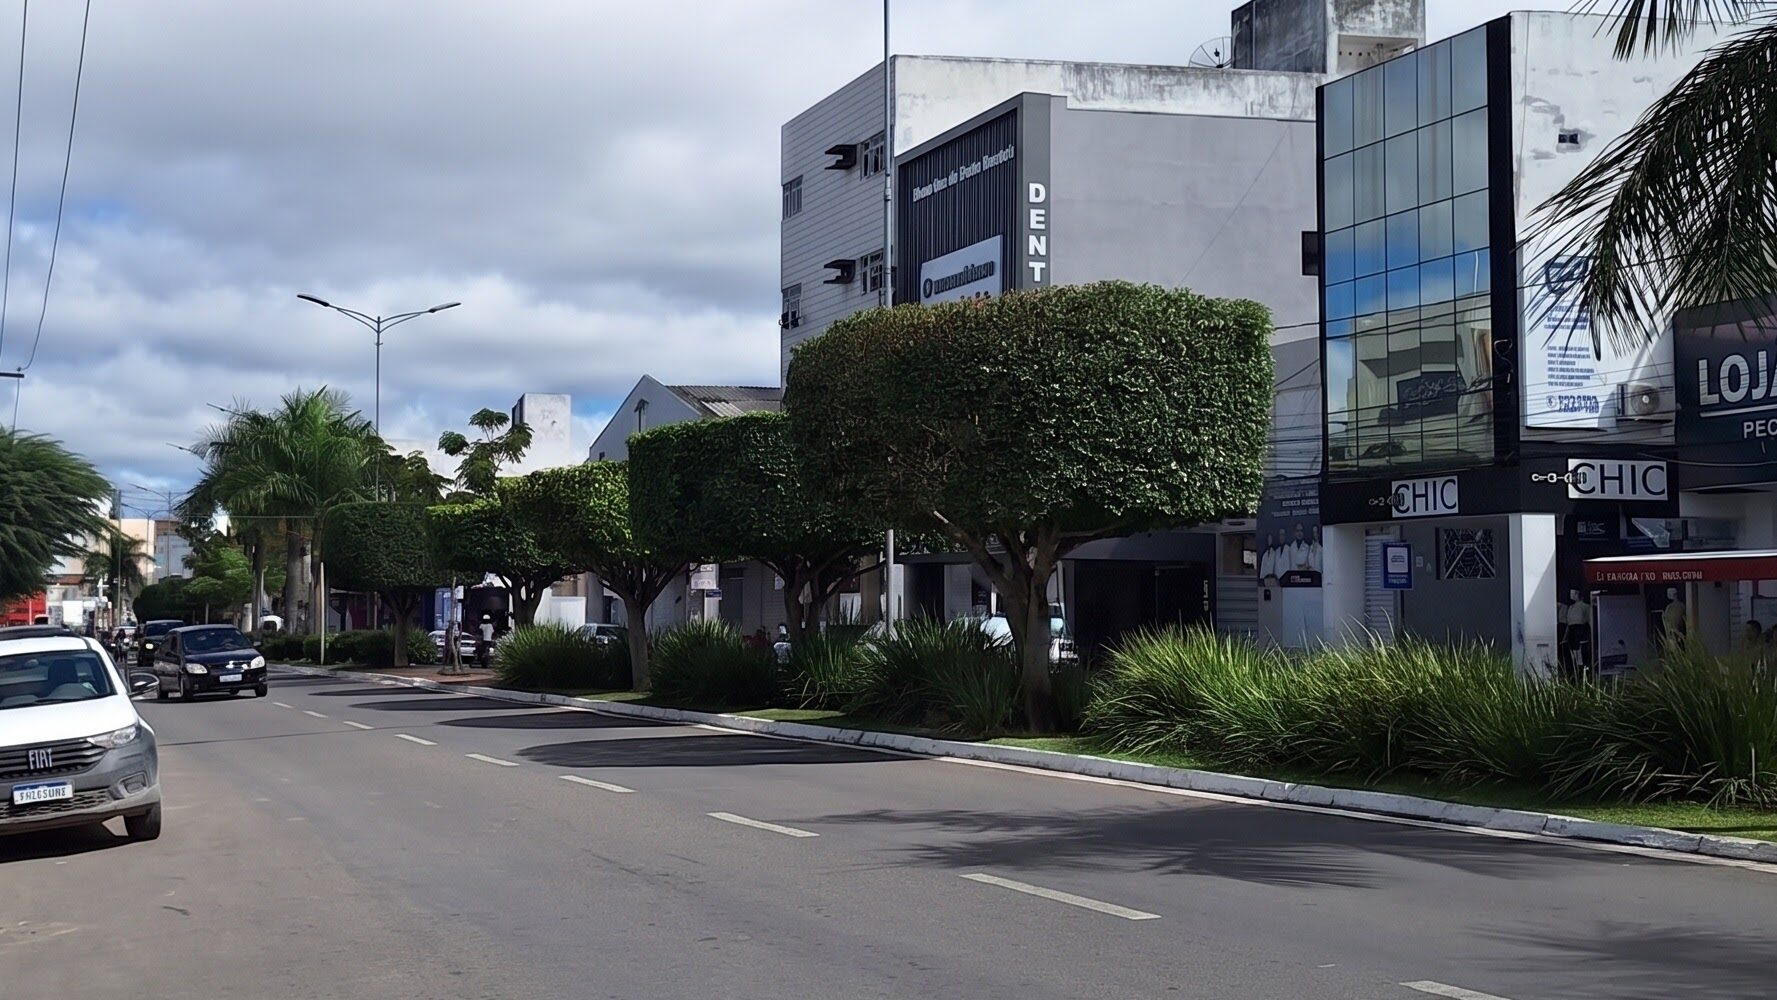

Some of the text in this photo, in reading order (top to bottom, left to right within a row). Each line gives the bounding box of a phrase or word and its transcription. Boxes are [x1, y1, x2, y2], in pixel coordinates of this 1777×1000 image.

[1570, 462, 1666, 496] CHIC
[1393, 479, 1457, 514] CHIC
[28, 748, 53, 770] FIAT
